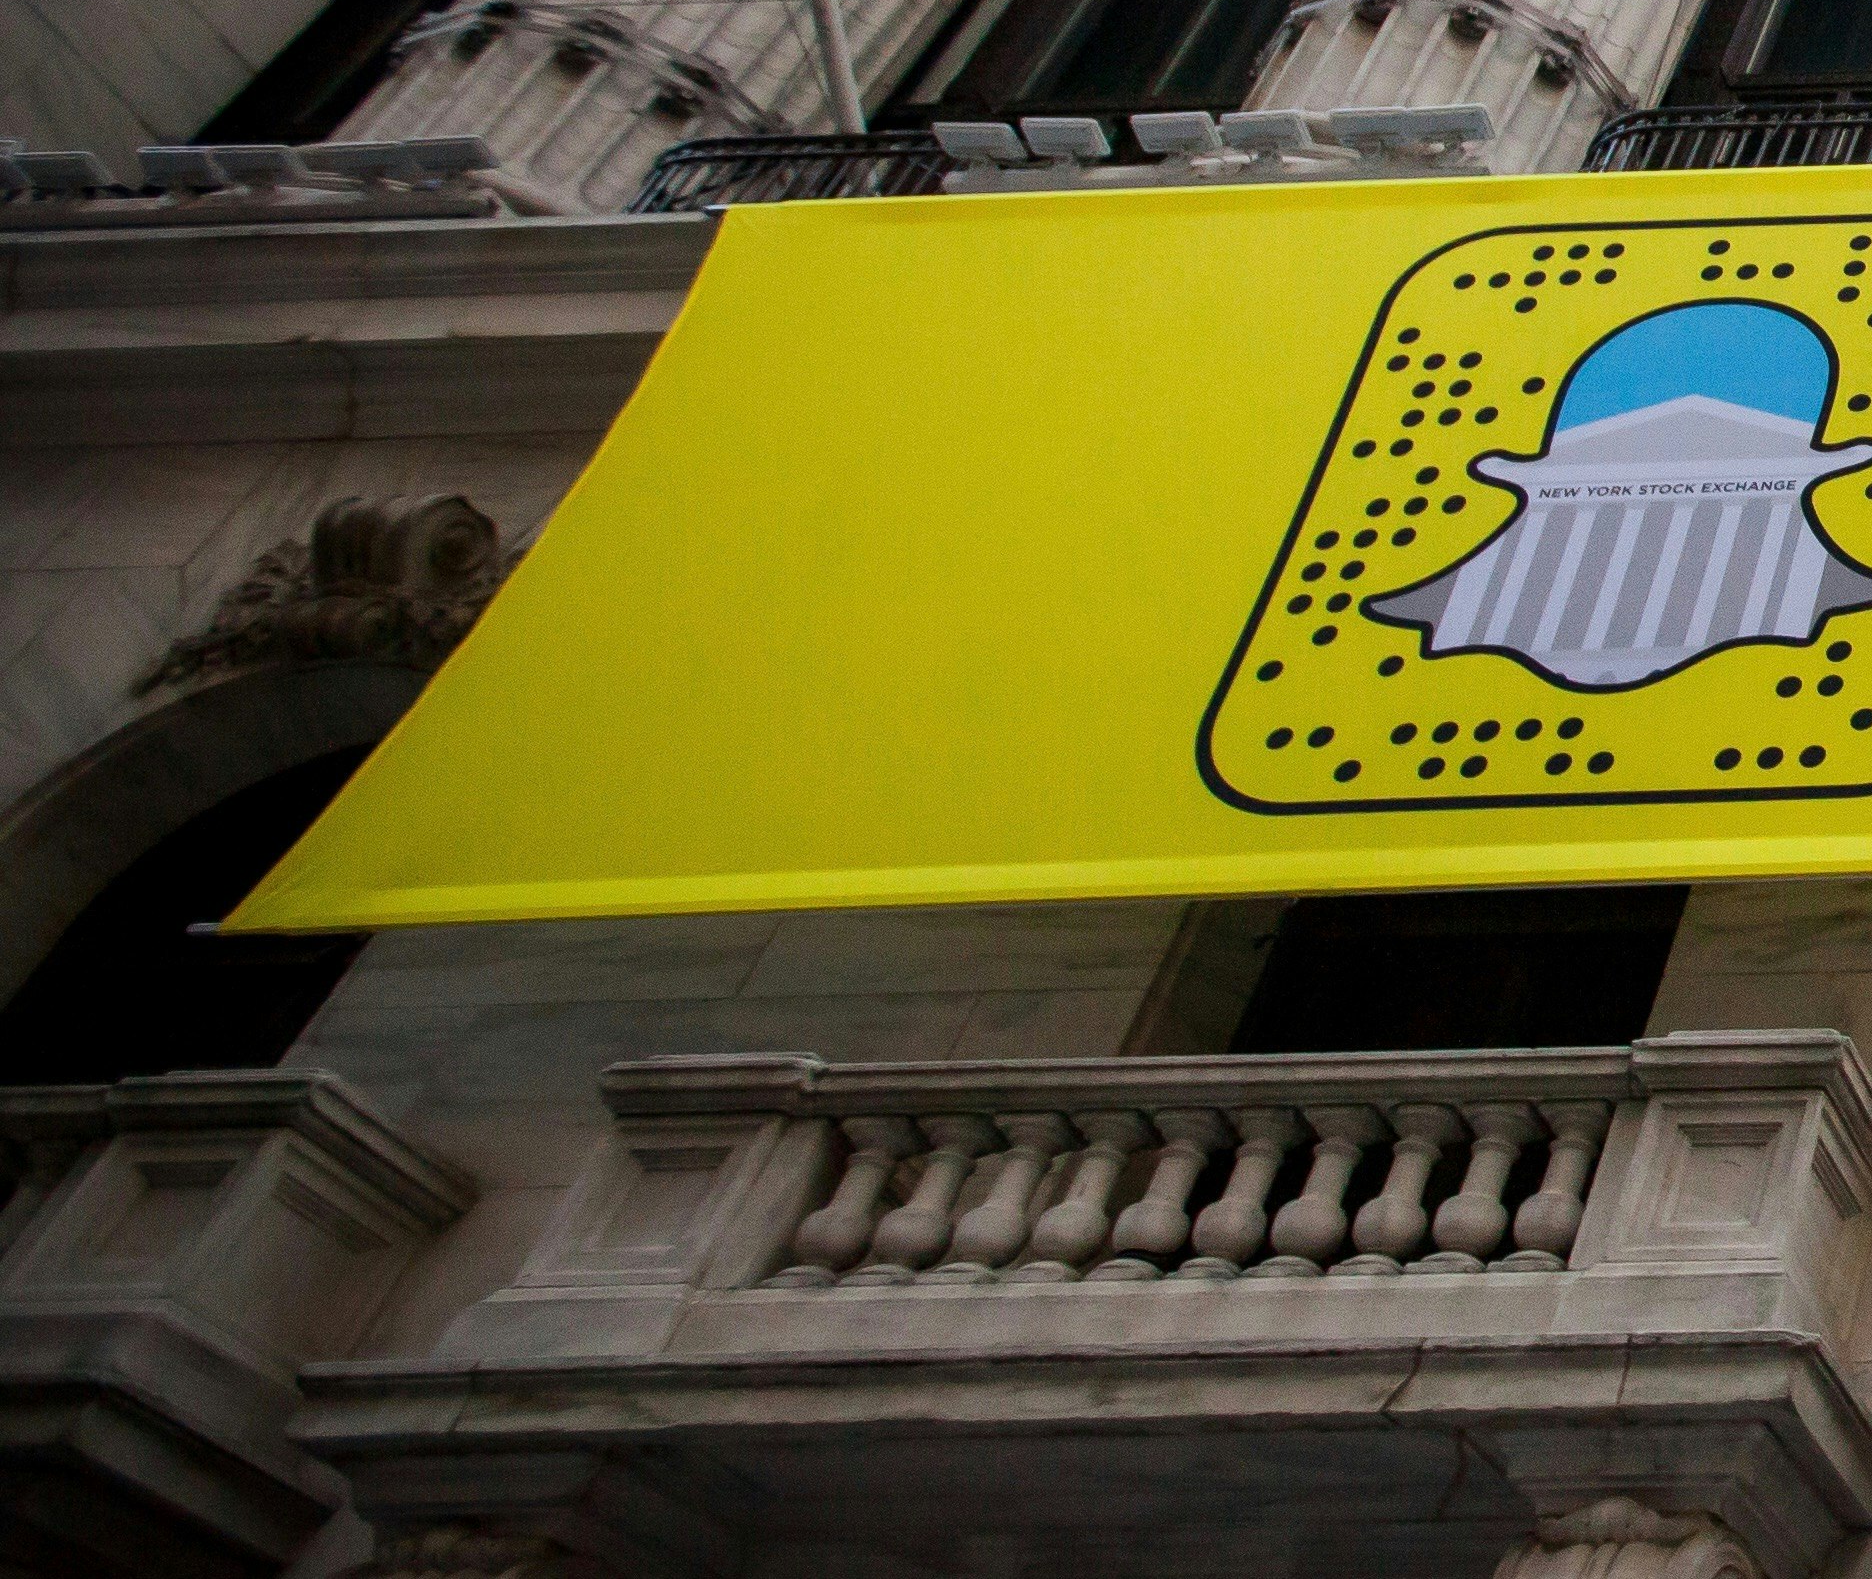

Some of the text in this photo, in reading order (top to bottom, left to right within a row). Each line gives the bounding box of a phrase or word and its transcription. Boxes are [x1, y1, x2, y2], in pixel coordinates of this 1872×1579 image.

[1538, 480, 1797, 499] NEW YORK STOCK EXCHANGE
